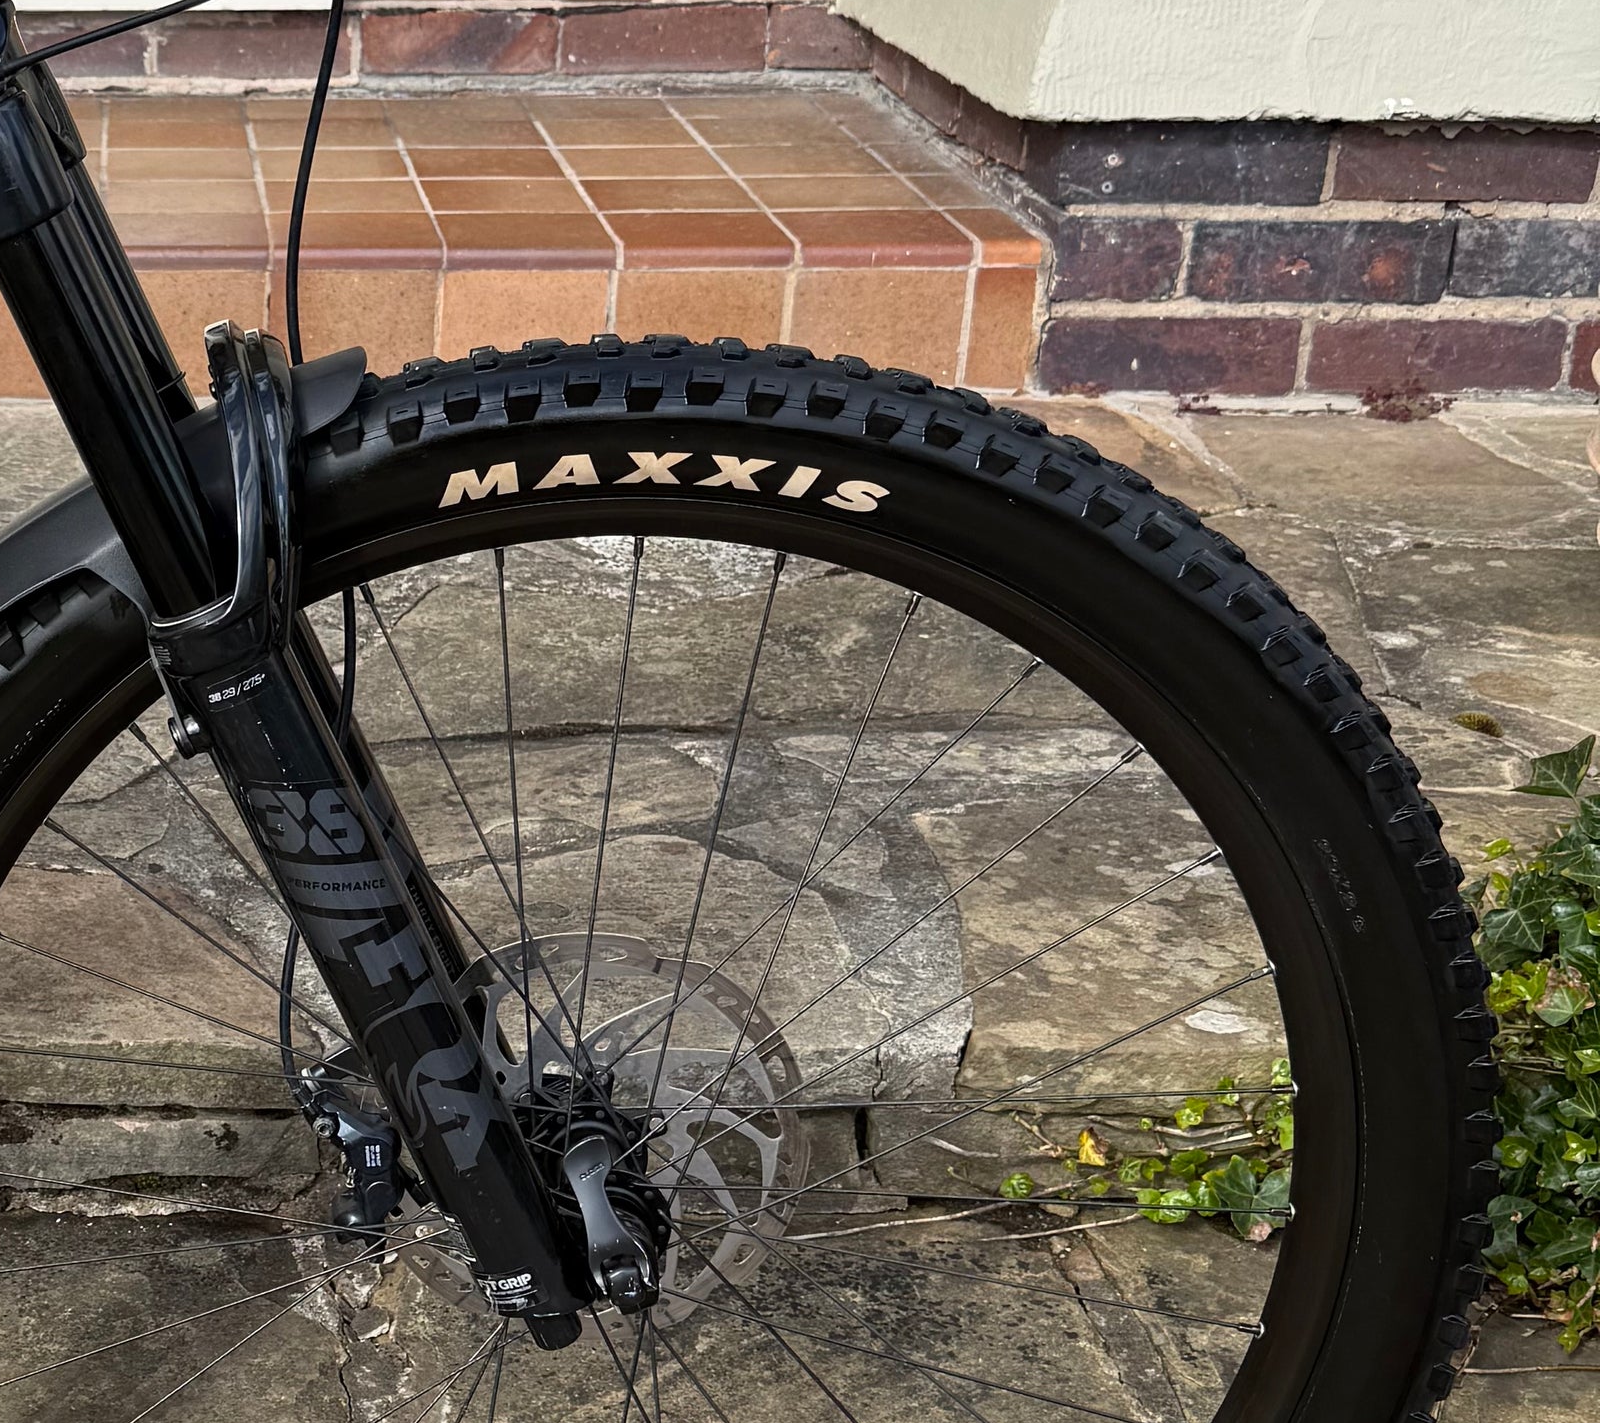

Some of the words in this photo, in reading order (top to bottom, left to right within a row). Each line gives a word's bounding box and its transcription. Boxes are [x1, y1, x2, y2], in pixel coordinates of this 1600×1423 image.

[438, 452, 891, 513] MAXXIS
[222, 686, 236, 700] 29
[248, 788, 366, 857] 38
[497, 1273, 533, 1291] GRIP
